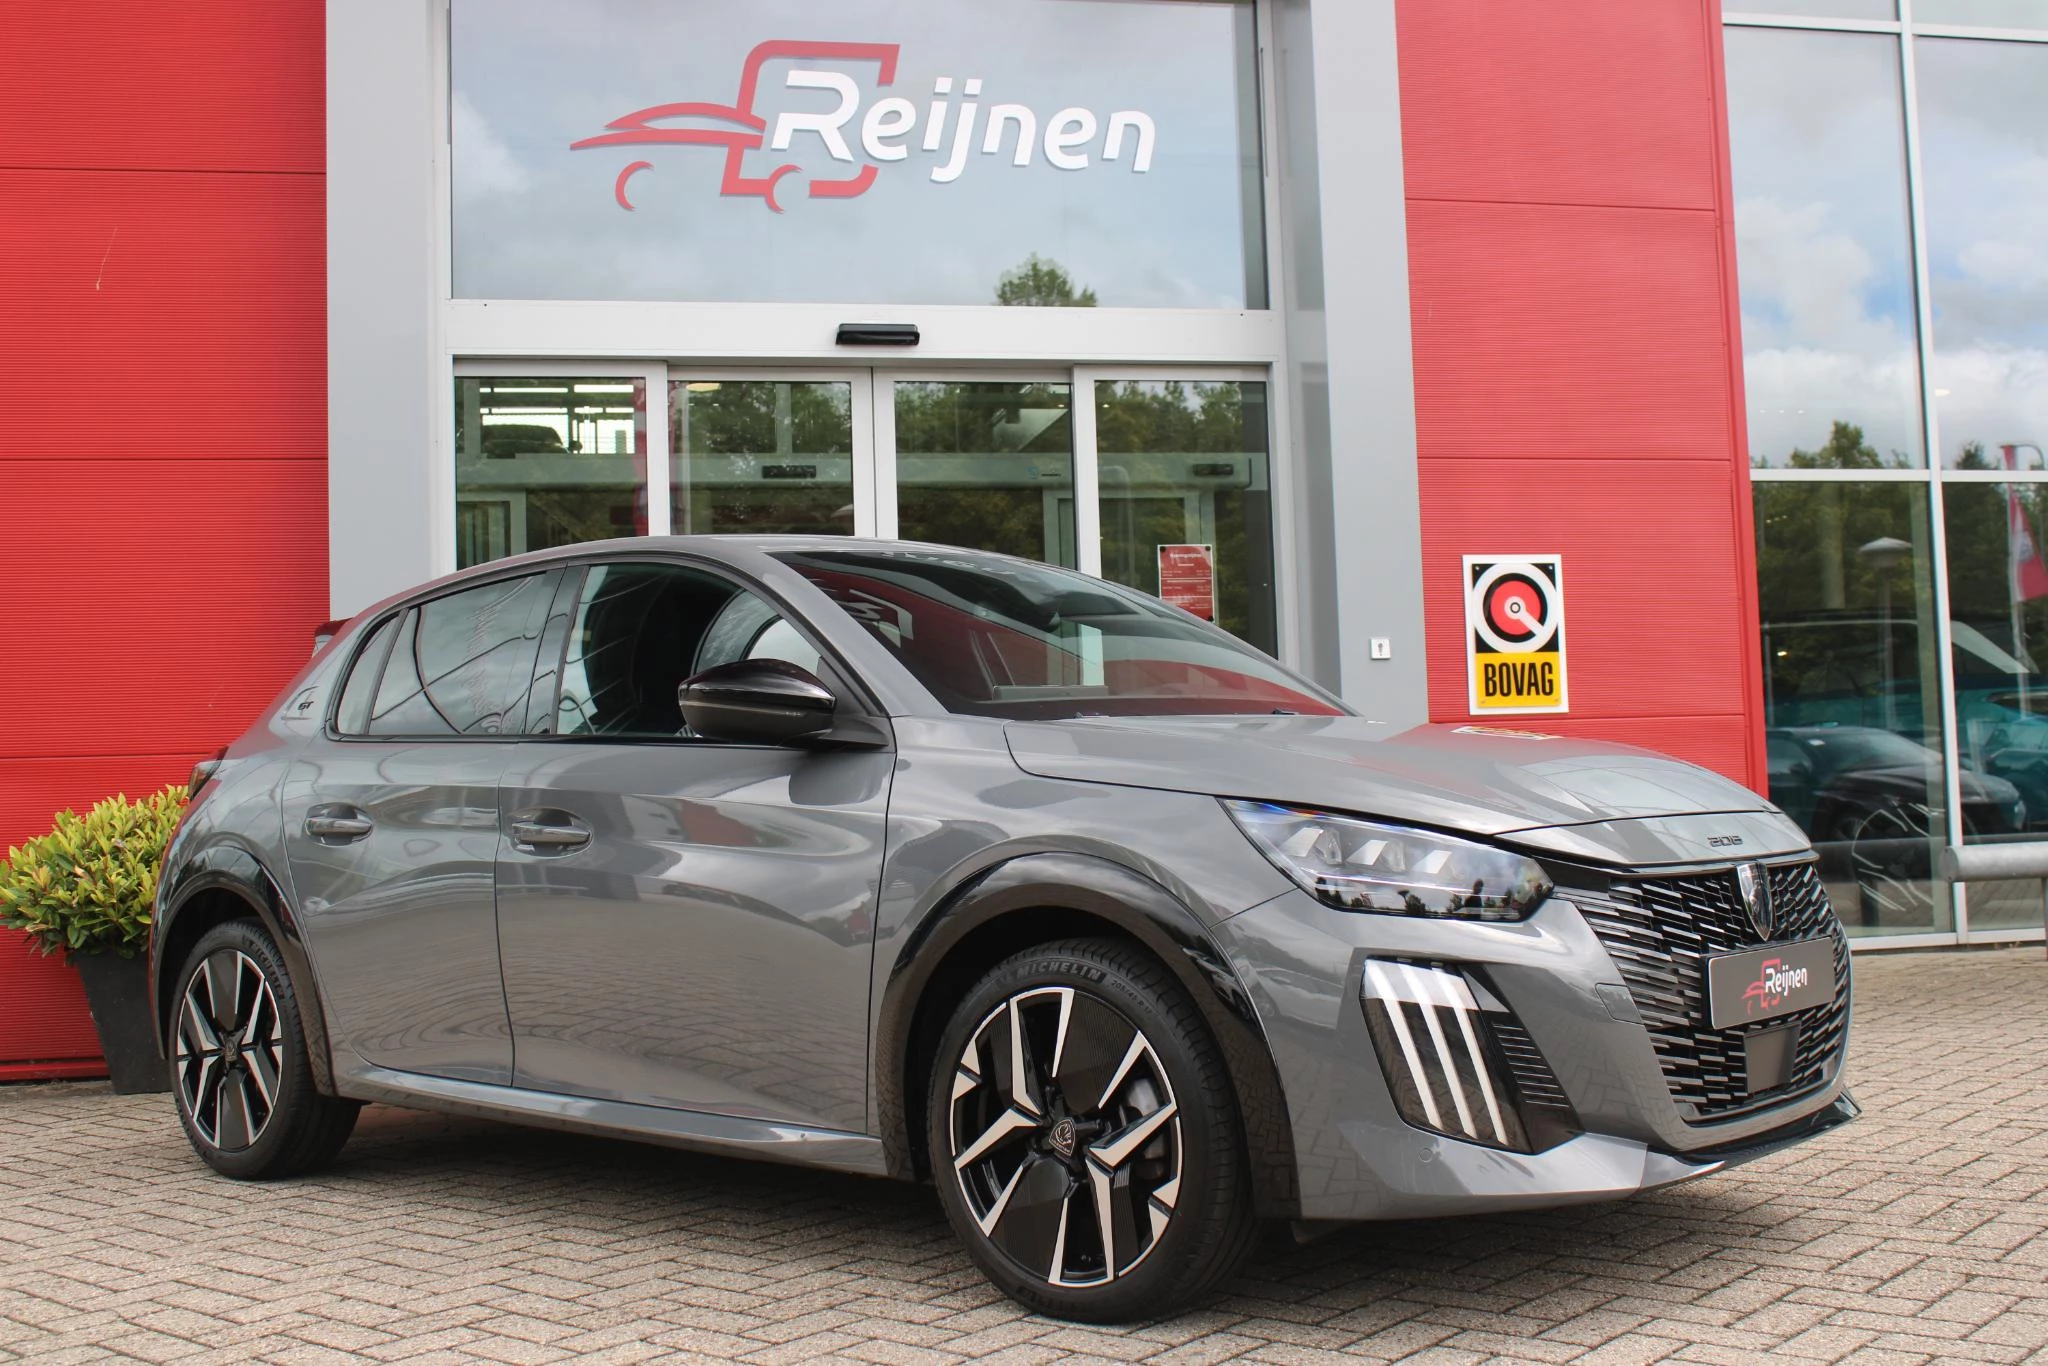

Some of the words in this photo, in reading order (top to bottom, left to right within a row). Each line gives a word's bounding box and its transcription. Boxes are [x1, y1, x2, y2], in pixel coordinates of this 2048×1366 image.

[770, 69, 1157, 183] Reijnen
[1484, 661, 1554, 697] BOVAG
[1017, 961, 1102, 981] MICHELIN
[1765, 964, 1808, 997] Reijnen
